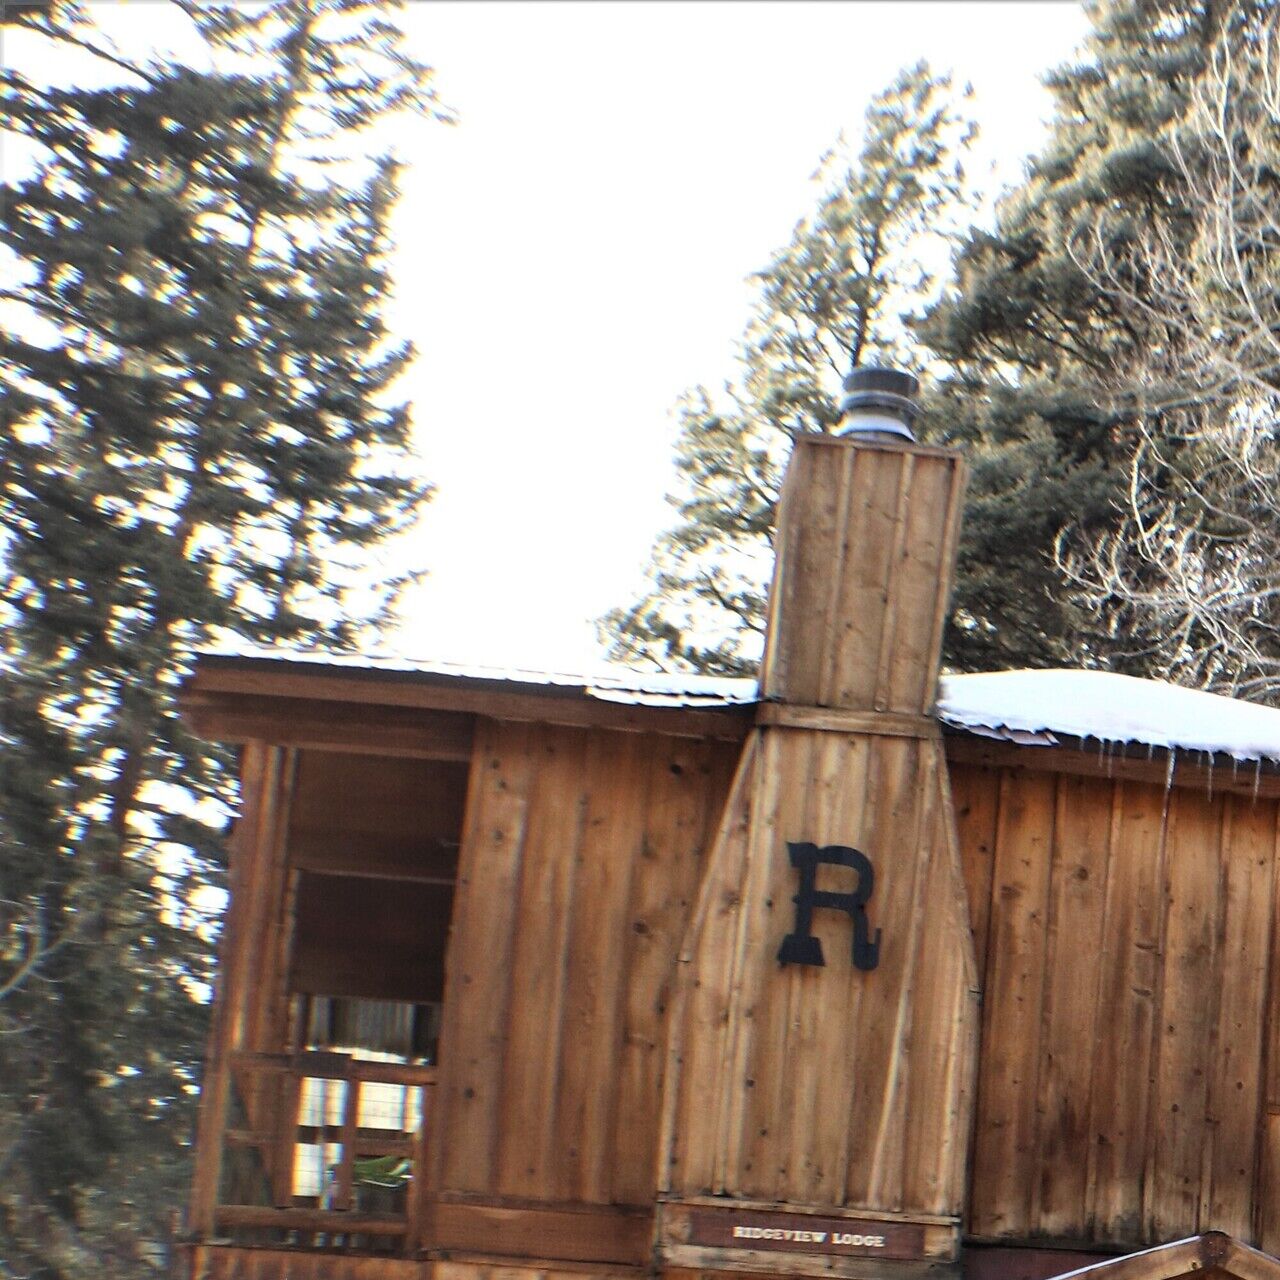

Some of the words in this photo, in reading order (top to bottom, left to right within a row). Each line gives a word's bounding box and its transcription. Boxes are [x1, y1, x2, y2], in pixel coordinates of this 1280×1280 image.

[777, 841, 882, 971] R
[733, 1226, 827, 1243] RIDGEVIEW
[832, 1232, 885, 1247] LODGE
